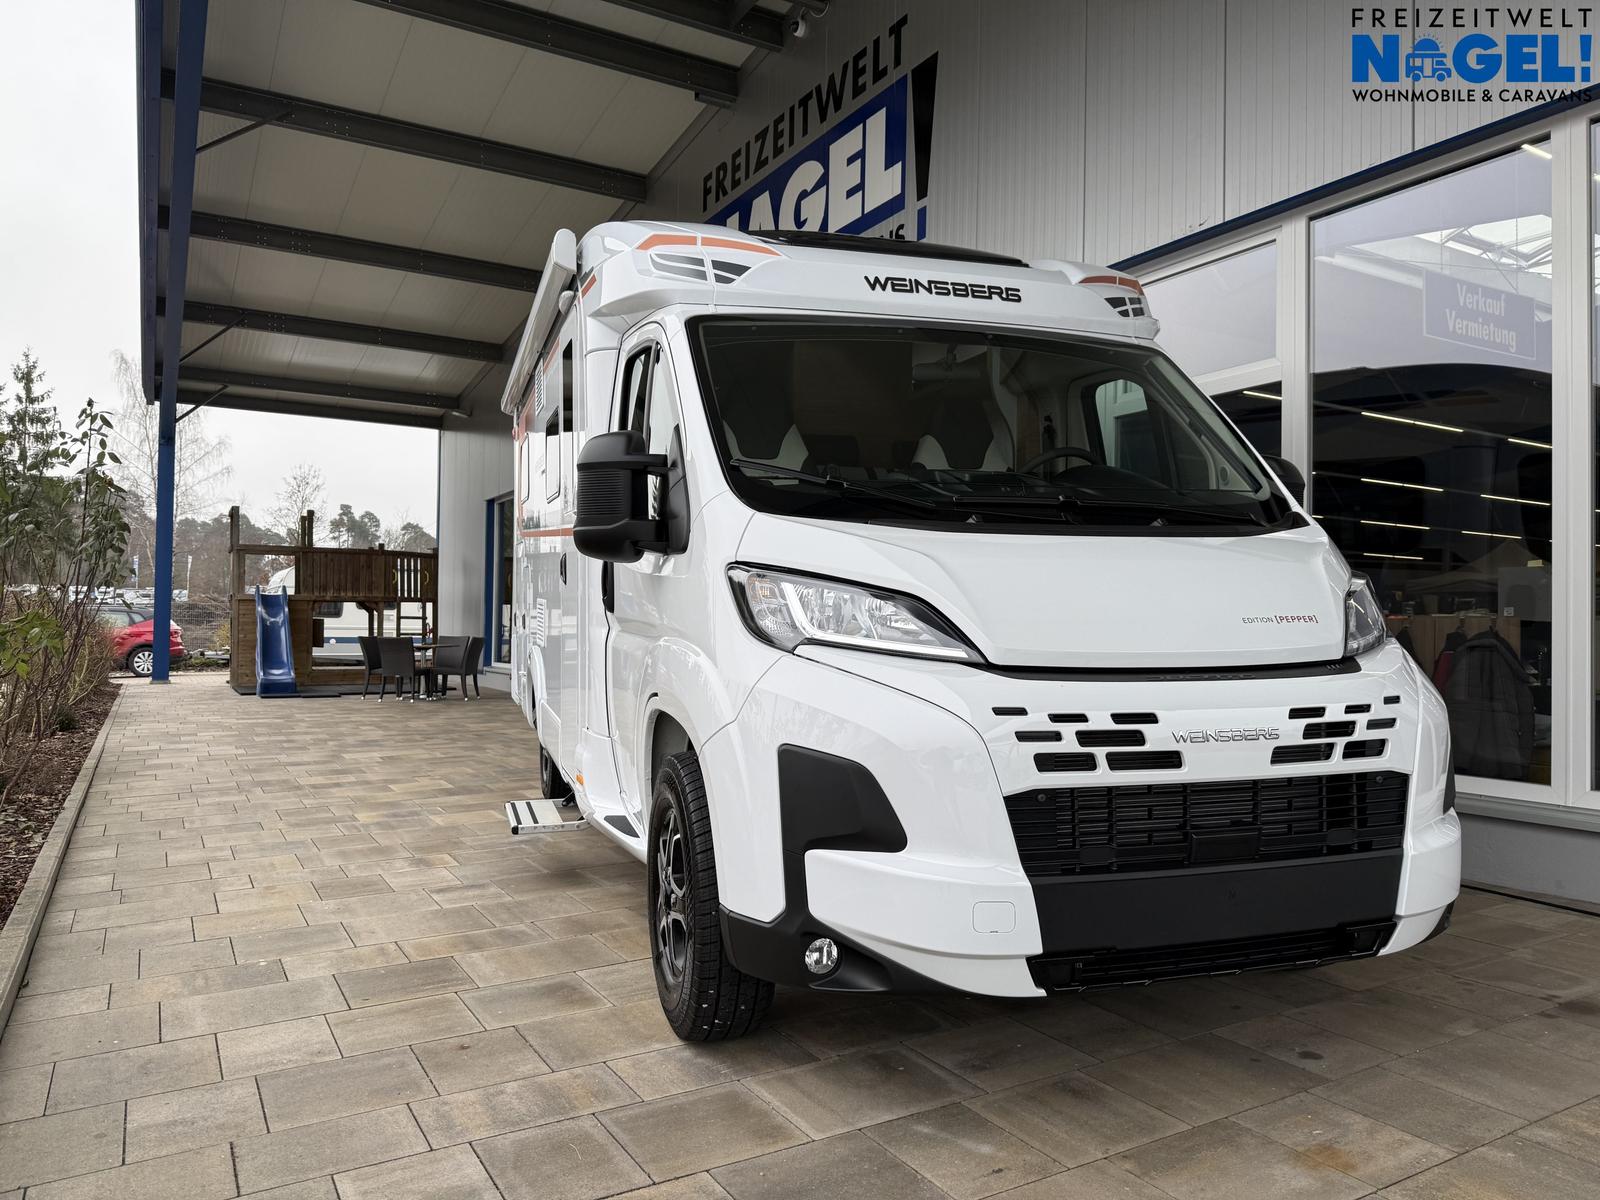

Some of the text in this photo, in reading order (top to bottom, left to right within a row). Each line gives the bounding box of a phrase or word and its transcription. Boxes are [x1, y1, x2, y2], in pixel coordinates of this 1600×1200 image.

[703, 14, 908, 213] FREIZEITWELT
[864, 275, 1022, 303] WEINSBERG
[1457, 282, 1505, 317] Verkauf
[1446, 308, 1517, 353] Vermietung
[1241, 616, 1274, 624] EDITION
[1171, 728, 1280, 744] WEINSBERG
